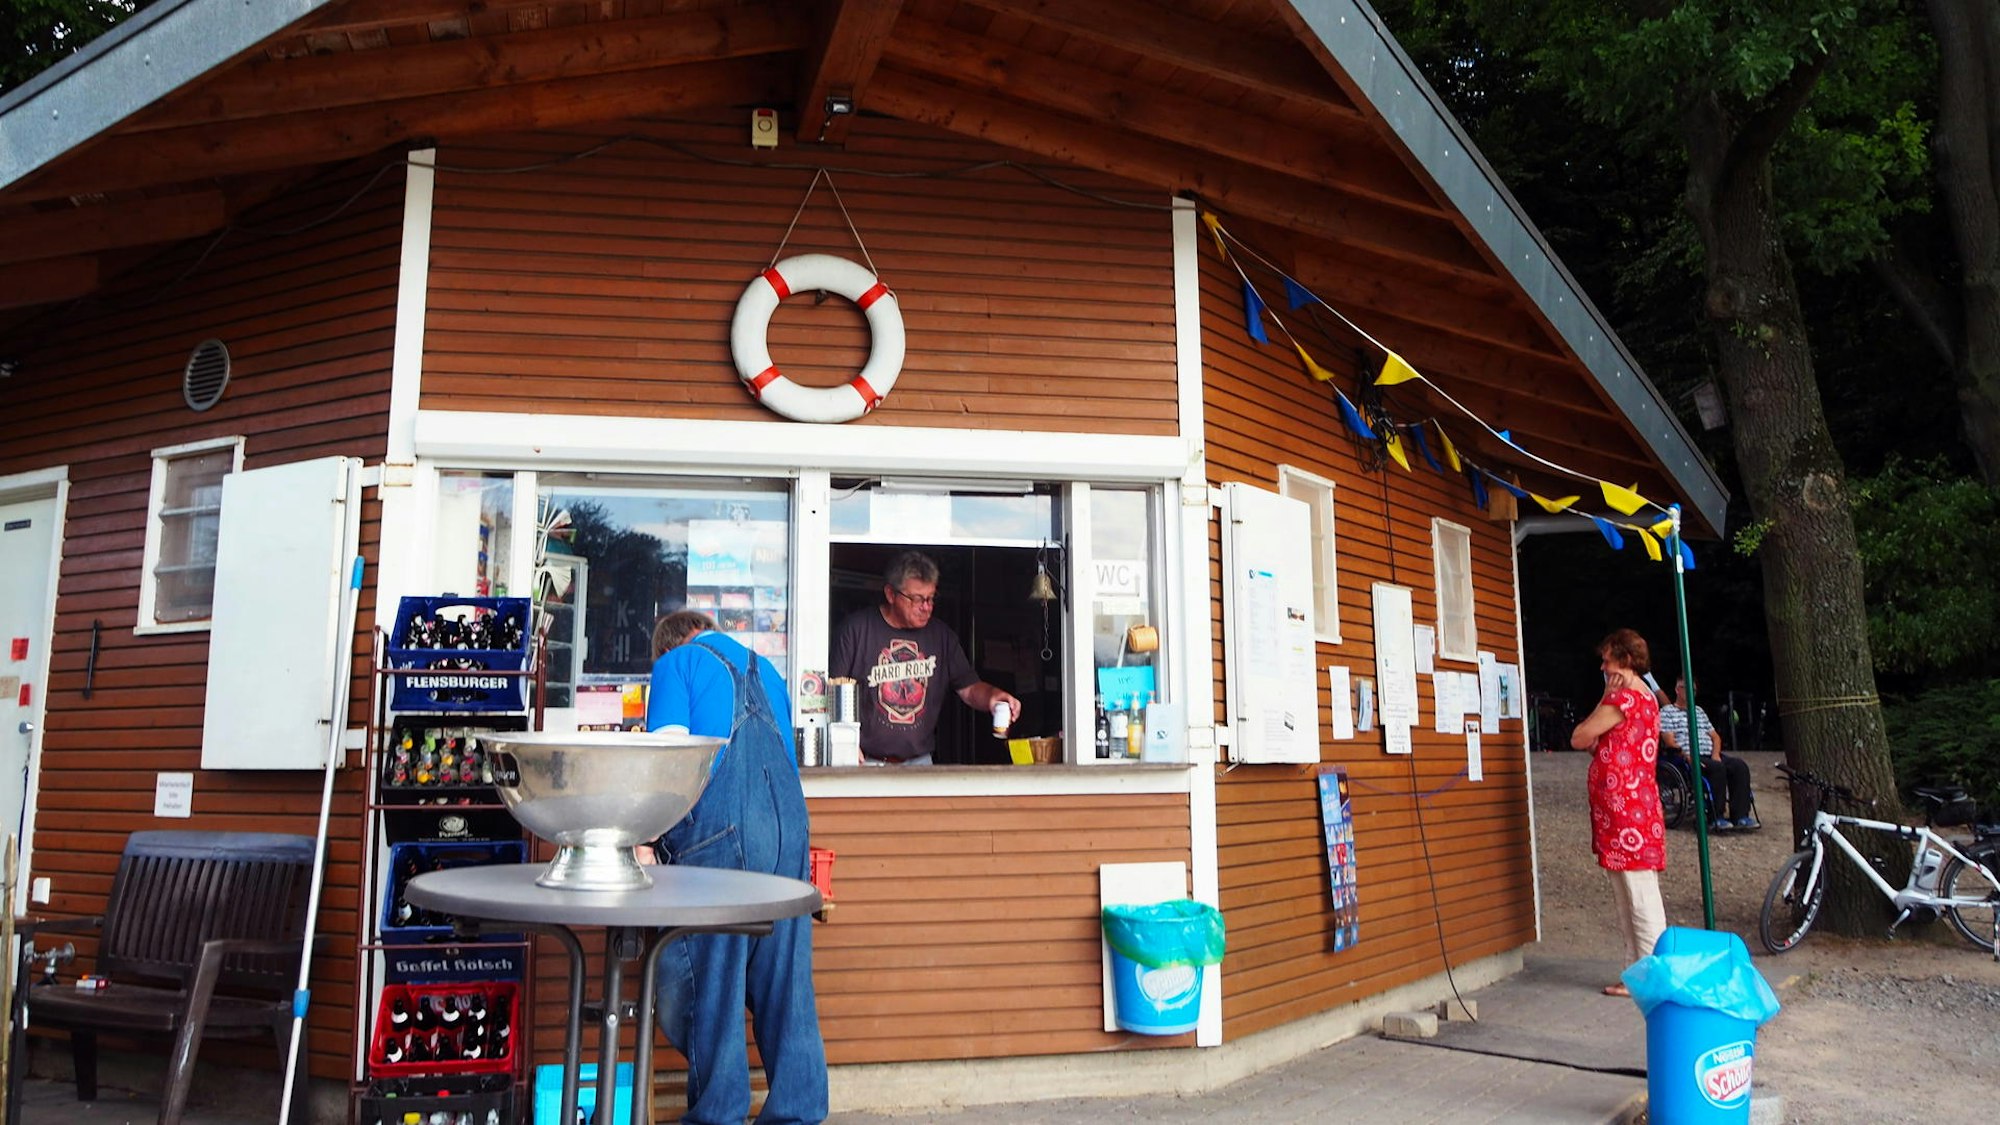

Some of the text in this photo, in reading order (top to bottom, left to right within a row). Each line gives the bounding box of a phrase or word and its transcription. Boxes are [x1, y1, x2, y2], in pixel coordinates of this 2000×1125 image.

[1096, 564, 1129, 586] WC
[874, 660, 931, 681] HARD ROCK
[406, 676, 508, 689] FLENSBURGER
